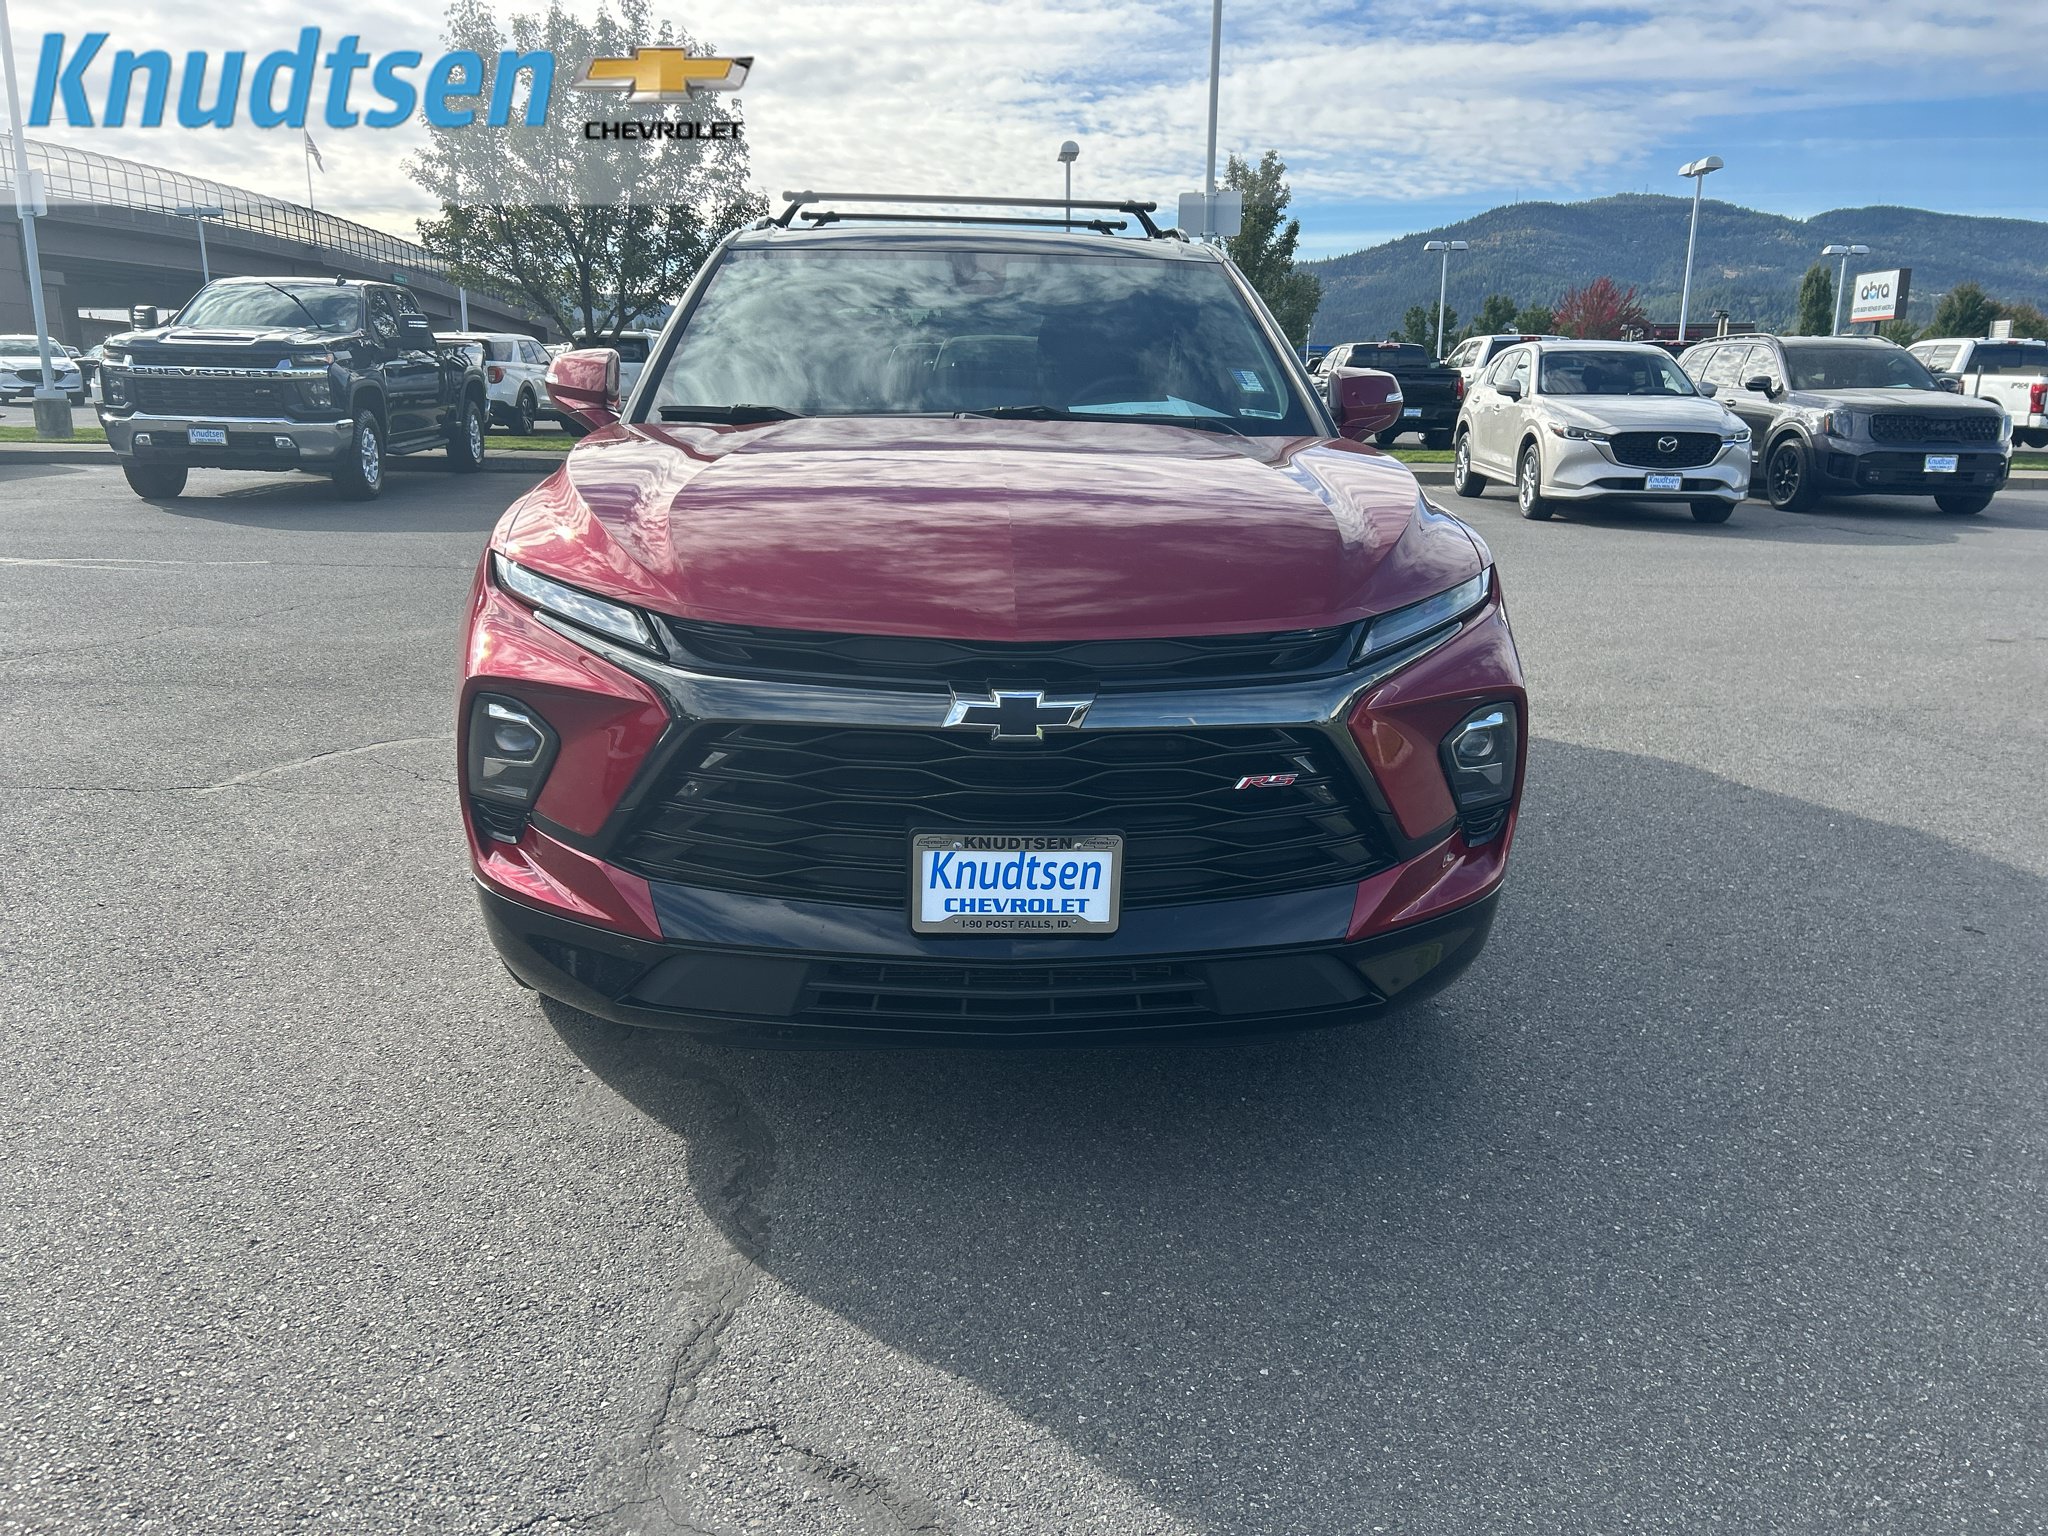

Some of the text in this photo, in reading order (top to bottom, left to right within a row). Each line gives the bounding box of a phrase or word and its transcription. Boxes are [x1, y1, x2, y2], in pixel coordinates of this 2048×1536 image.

[1861, 281, 1890, 300] abra
[133, 366, 279, 378] CHEVROLET
[191, 430, 225, 438] Knudtsen
[1649, 475, 1680, 484] Knudtsen
[1234, 773, 1299, 790] RS
[964, 836, 1073, 850] KNUDTSEN
[929, 851, 1102, 890] Knudtsen
[944, 898, 1090, 913] CHEVROLET
[962, 920, 1071, 930] I-90 POST FALLS, ID.
